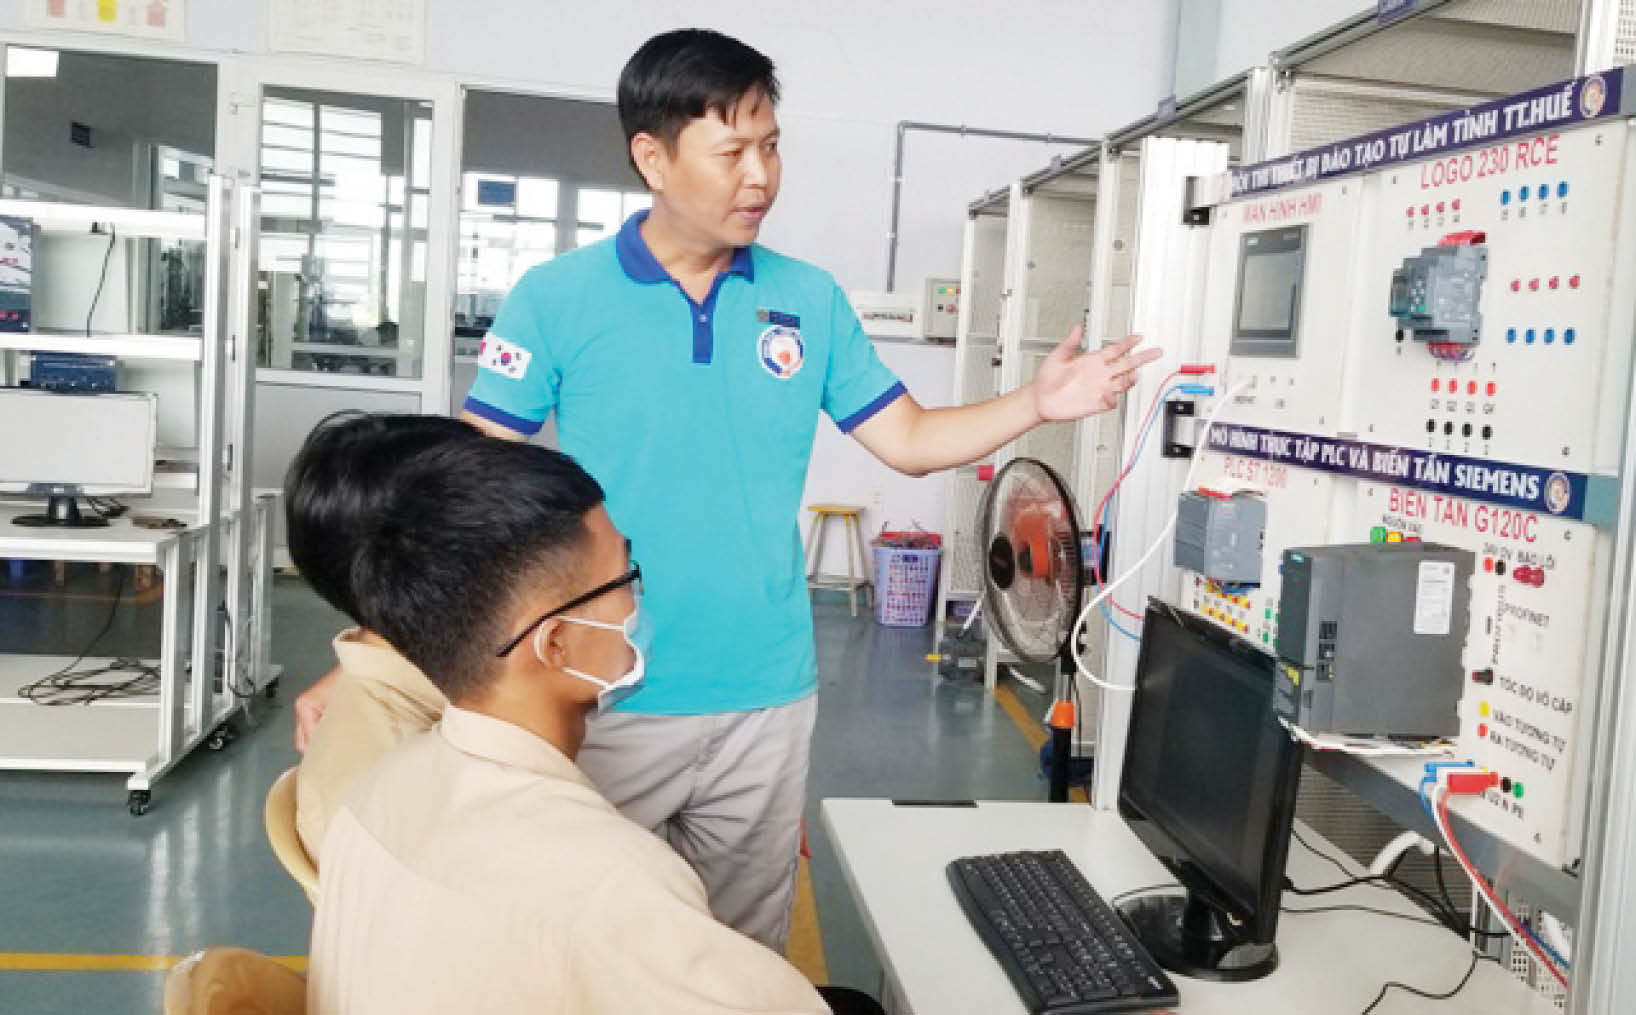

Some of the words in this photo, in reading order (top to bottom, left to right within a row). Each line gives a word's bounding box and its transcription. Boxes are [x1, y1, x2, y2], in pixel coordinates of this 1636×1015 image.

[1354, 137, 1385, 167] TẠO
[1390, 129, 1412, 160] TỰ
[1413, 121, 1449, 152] LÀM
[1452, 109, 1499, 144] TỈNH
[1421, 154, 1473, 190] LOGO
[1477, 144, 1509, 179] 230
[1515, 133, 1561, 170] RCE
[1321, 443, 1345, 466] PLC
[1350, 444, 1369, 471] VÀ
[1373, 448, 1409, 477] BIẾN
[1414, 452, 1450, 485] TẦN
[1454, 464, 1540, 499] SIEMENS
[1475, 505, 1539, 543] G120C
